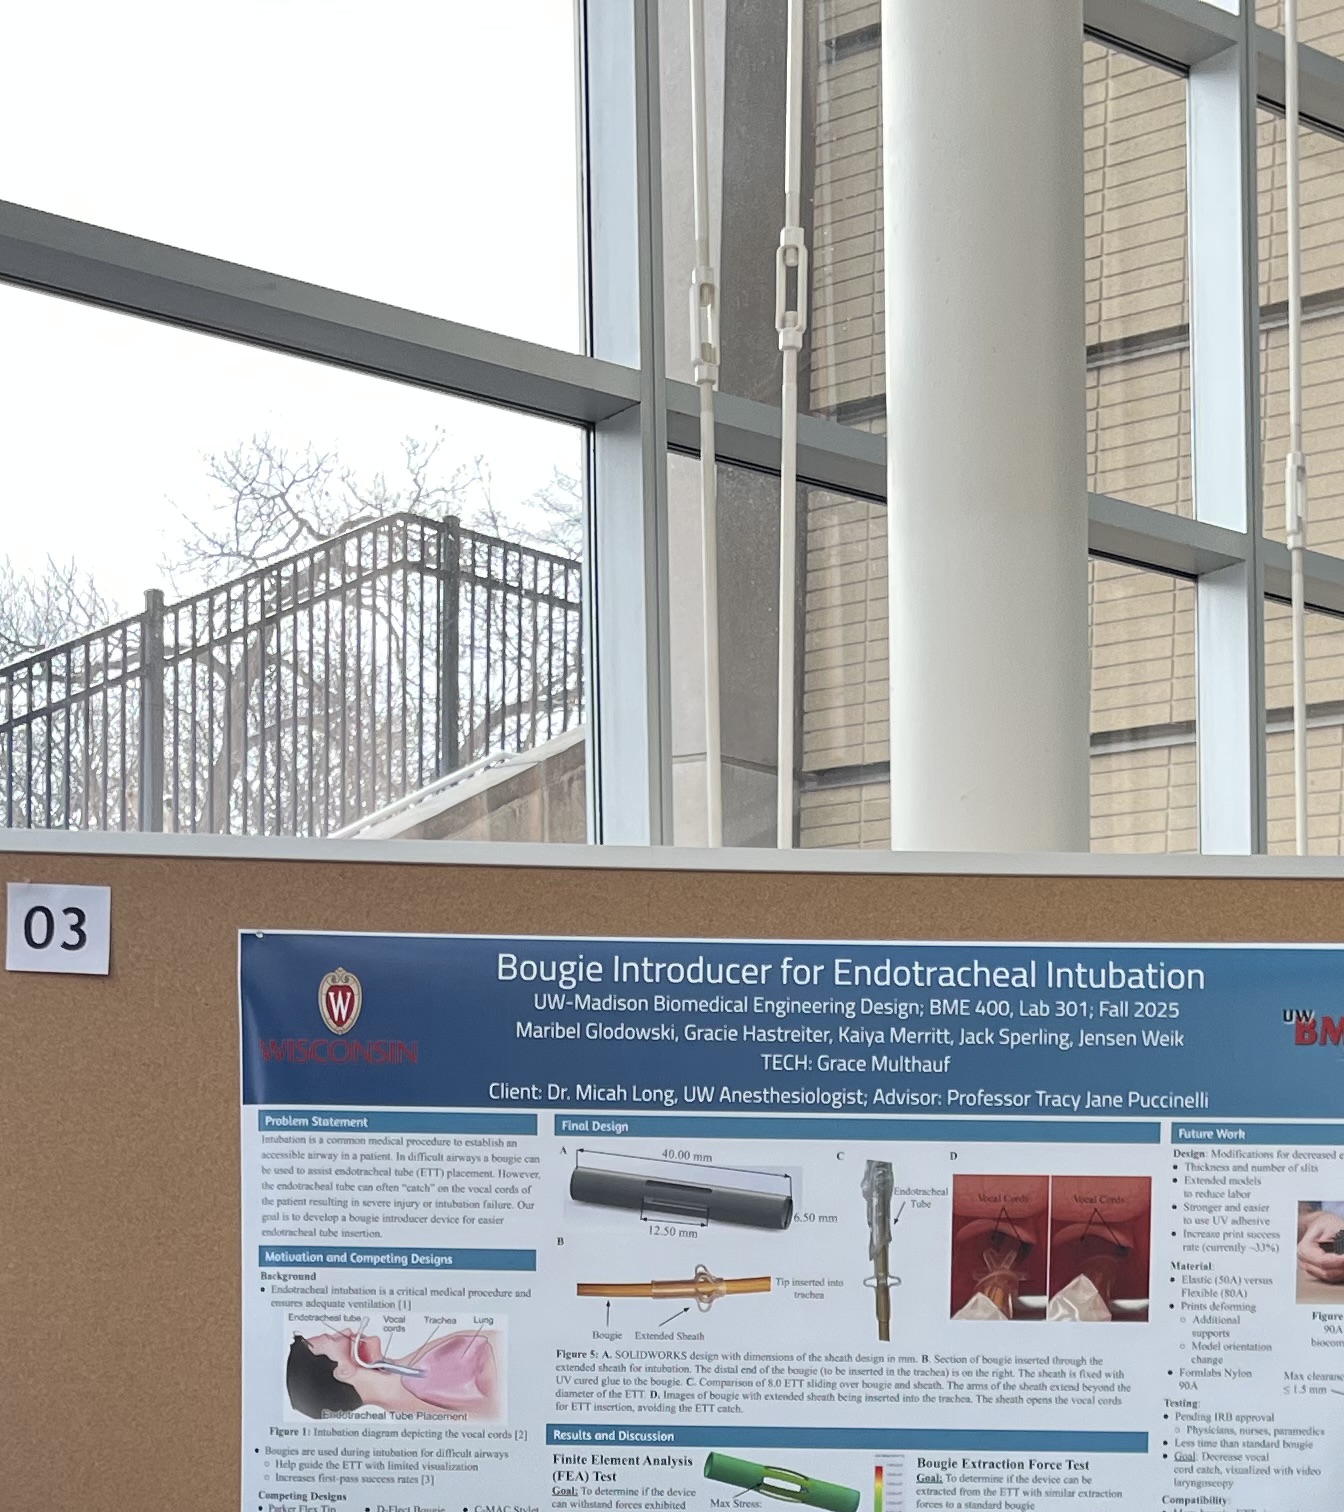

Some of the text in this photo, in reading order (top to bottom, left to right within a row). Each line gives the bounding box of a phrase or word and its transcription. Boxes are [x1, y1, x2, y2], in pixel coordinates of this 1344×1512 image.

[24, 905, 87, 951] 03
[497, 953, 1204, 990] Bougie Introducer for Endotracheal Intubation
[329, 990, 351, 1021] W
[534, 993, 1179, 1020] UW-Madison Biomedical Engineering Design; BME 400, Lab 301; Fall 2025
[1283, 1009, 1314, 1024] UW
[516, 1021, 1184, 1050] Maribel Glodowski, Gracie Hastreiter, Kaiya Merritt, Jack Sperling, Jensen Weik
[258, 1038, 419, 1064] WISCONSIN
[761, 1053, 950, 1073] TECH: Grace Multhauf
[489, 1082, 1208, 1111] Client: Dr. Micah Long, UW Anesthesiologist; Advisor: Professor Tracy Jane Puccinelli
[263, 1114, 368, 1128] Problem Statement
[561, 1119, 628, 1134] Final Design
[1178, 1128, 1246, 1140] Future Work
[560, 1146, 567, 1155] A
[662, 1148, 712, 1162] 40.00 mm
[836, 1152, 844, 1160] C
[950, 1152, 957, 1161] D
[794, 1213, 838, 1223] 6.50 mm
[648, 1225, 698, 1238] 12.50 mm
[557, 1237, 564, 1246] B
[264, 1250, 453, 1267] Motivation and Competing Designs
[260, 1271, 317, 1282] Background
[287, 1312, 364, 1323] Endotracheal tube
[382, 1315, 406, 1326] Vocal
[424, 1315, 457, 1325] Trachea
[473, 1315, 494, 1327] Lung
[382, 1324, 406, 1335] cords
[634, 1330, 705, 1341] Extended Sheath
[592, 1330, 622, 1342] Bougie
[1165, 1398, 1200, 1409] Testing:
[320, 1409, 469, 1421] Endotracheal Tube Placement
[553, 1429, 674, 1442] Results and Discussion
[553, 1453, 693, 1466] Finite Element Analysis
[917, 1457, 1089, 1471] Bougie Extraction Force Test
[552, 1470, 616, 1483] (FEA) Test
[258, 1490, 347, 1502] Competing Designs
[268, 1504, 296, 1512] Parker
[710, 1498, 762, 1508] Max Stress:
